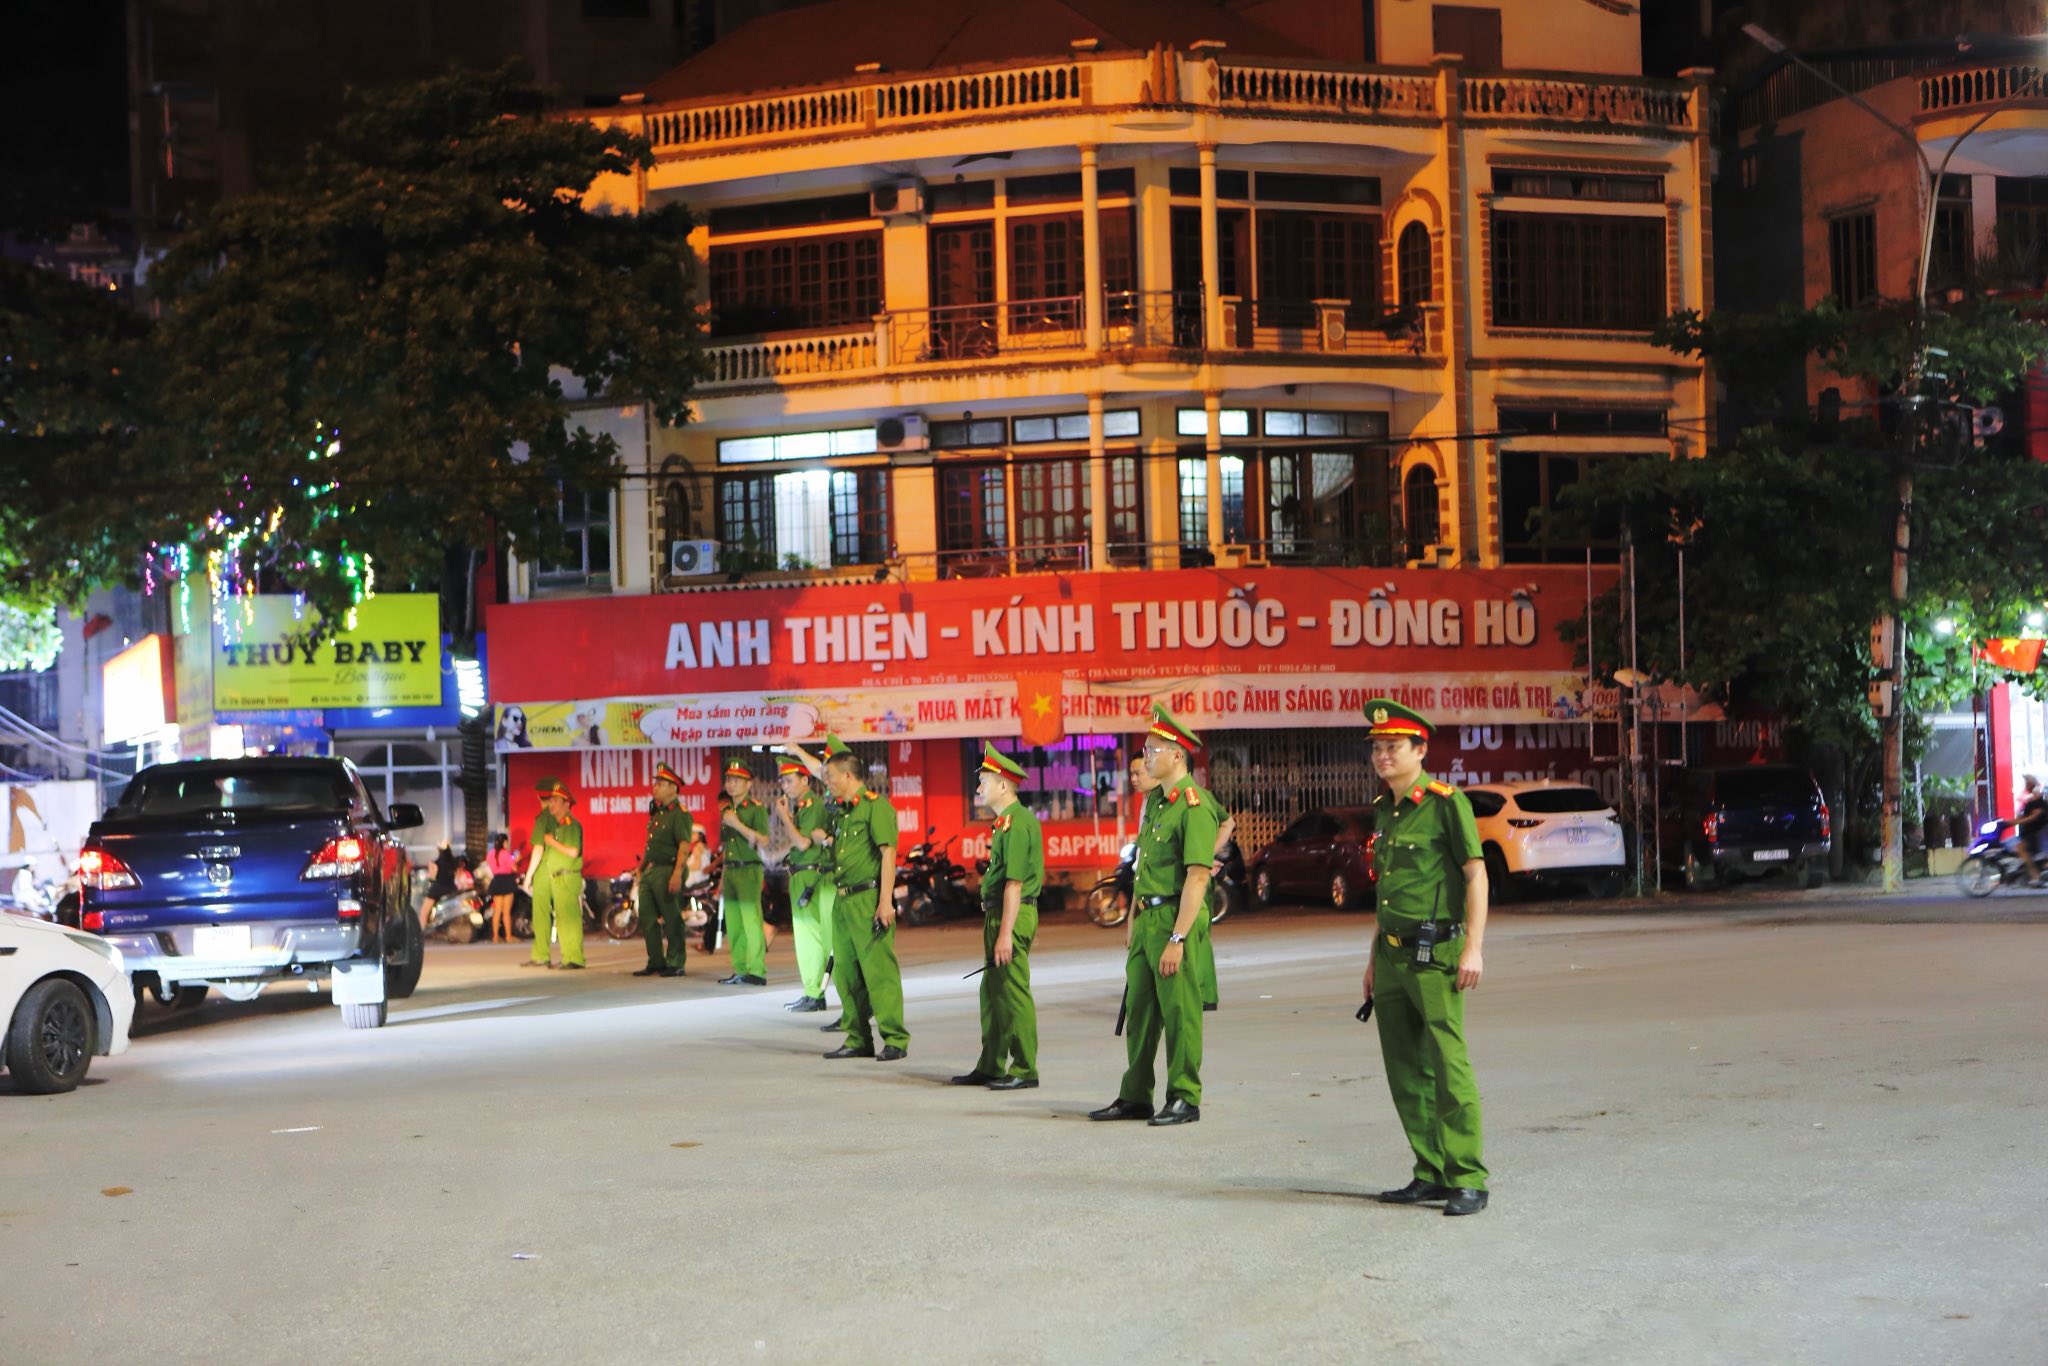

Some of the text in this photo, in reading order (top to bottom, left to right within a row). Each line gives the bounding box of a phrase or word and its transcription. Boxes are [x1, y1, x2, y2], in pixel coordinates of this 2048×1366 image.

[665, 619, 771, 669] ANH
[784, 602, 928, 672] THIỆN
[972, 595, 1095, 657] KÍNH
[1112, 582, 1286, 650] THUỐC
[1328, 582, 1461, 646] ĐỒNG
[1474, 582, 1539, 646] HỒ
[334, 640, 426, 664] BABY
[1202, 664, 1242, 674] QUANG
[918, 700, 957, 722] MUA
[965, 689, 1004, 720] MẮT
[1126, 693, 1152, 716] U2
[1203, 690, 1237, 719] LỌC
[1285, 683, 1333, 712] SÁNG
[677, 706, 702, 720] Mua
[671, 727, 702, 743] Ngập
